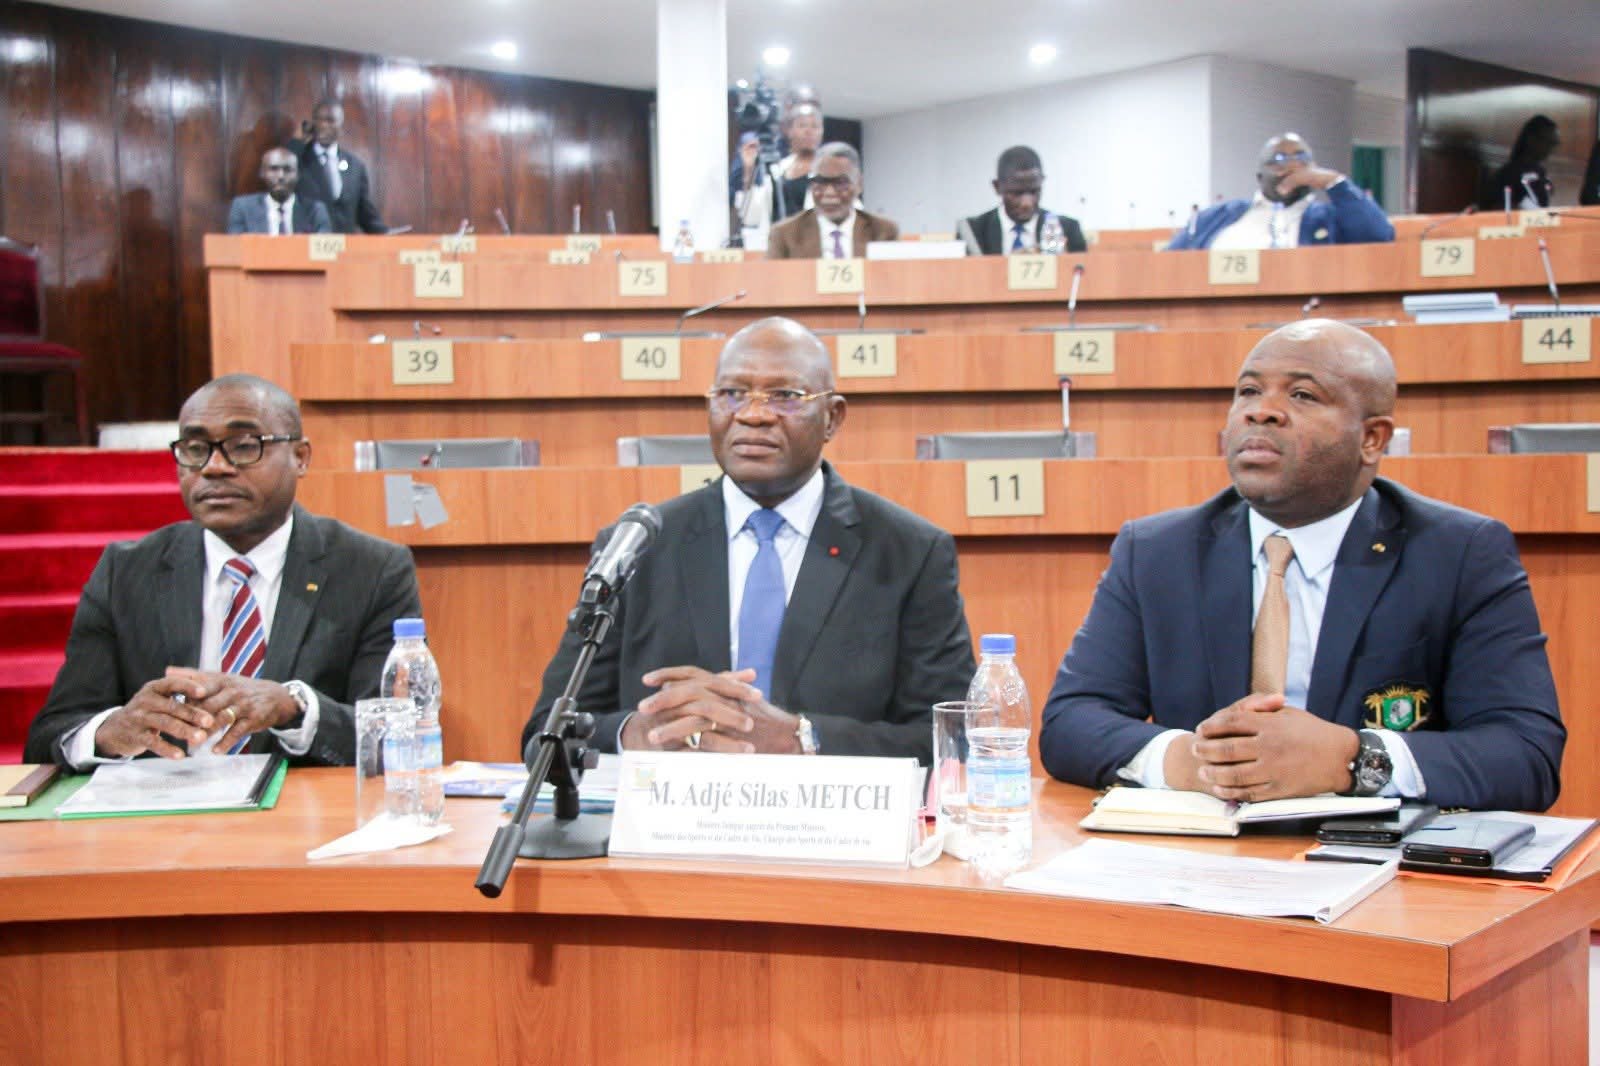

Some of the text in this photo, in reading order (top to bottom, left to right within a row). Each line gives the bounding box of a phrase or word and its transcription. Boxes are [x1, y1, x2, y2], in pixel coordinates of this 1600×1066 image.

[1222, 256, 1247, 274] 78
[1434, 246, 1462, 265] 79
[427, 268, 452, 287] 74
[631, 267, 656, 286] 75
[829, 265, 853, 283] 76
[1020, 261, 1045, 279] 77
[1538, 327, 1575, 350] 44
[408, 350, 439, 373] 39
[635, 347, 667, 370] 40
[851, 344, 880, 365] 41
[1068, 341, 1100, 363] 42
[988, 474, 1021, 502] 11
[649, 780, 892, 814] M. Adjé Silas METCH
